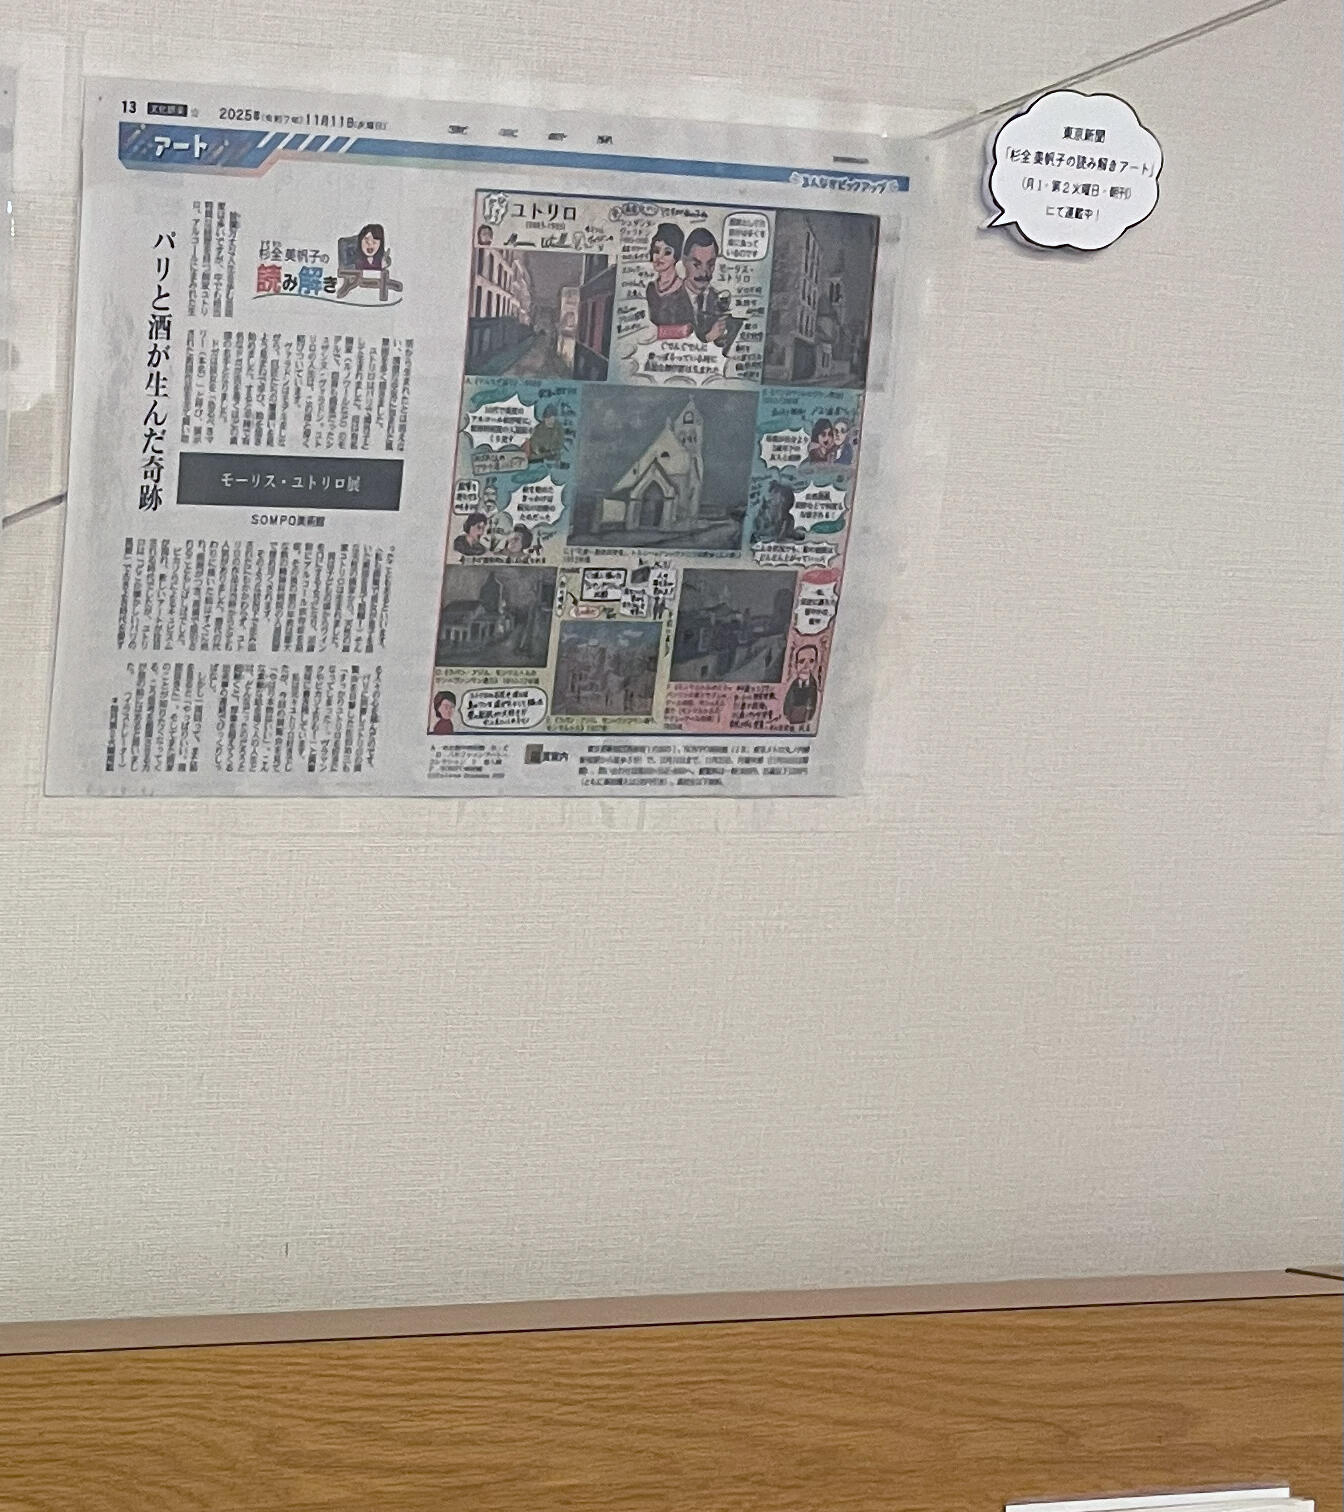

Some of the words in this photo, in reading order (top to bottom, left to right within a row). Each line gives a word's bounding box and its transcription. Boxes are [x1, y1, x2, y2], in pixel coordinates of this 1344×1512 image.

[121, 100, 137, 114] 13
[1063, 126, 1106, 143] 東京新聞
[154, 134, 208, 158] アート
[512, 203, 576, 221] ユトリロ
[258, 246, 330, 264] 杉全美帆子の
[256, 264, 403, 302] 読み解きアート
[138, 231, 177, 511] パリと酒が生んだ奇跡
[222, 473, 360, 492] モーリス・ユトリロ展
[251, 514, 325, 528] SOMPO美術館
